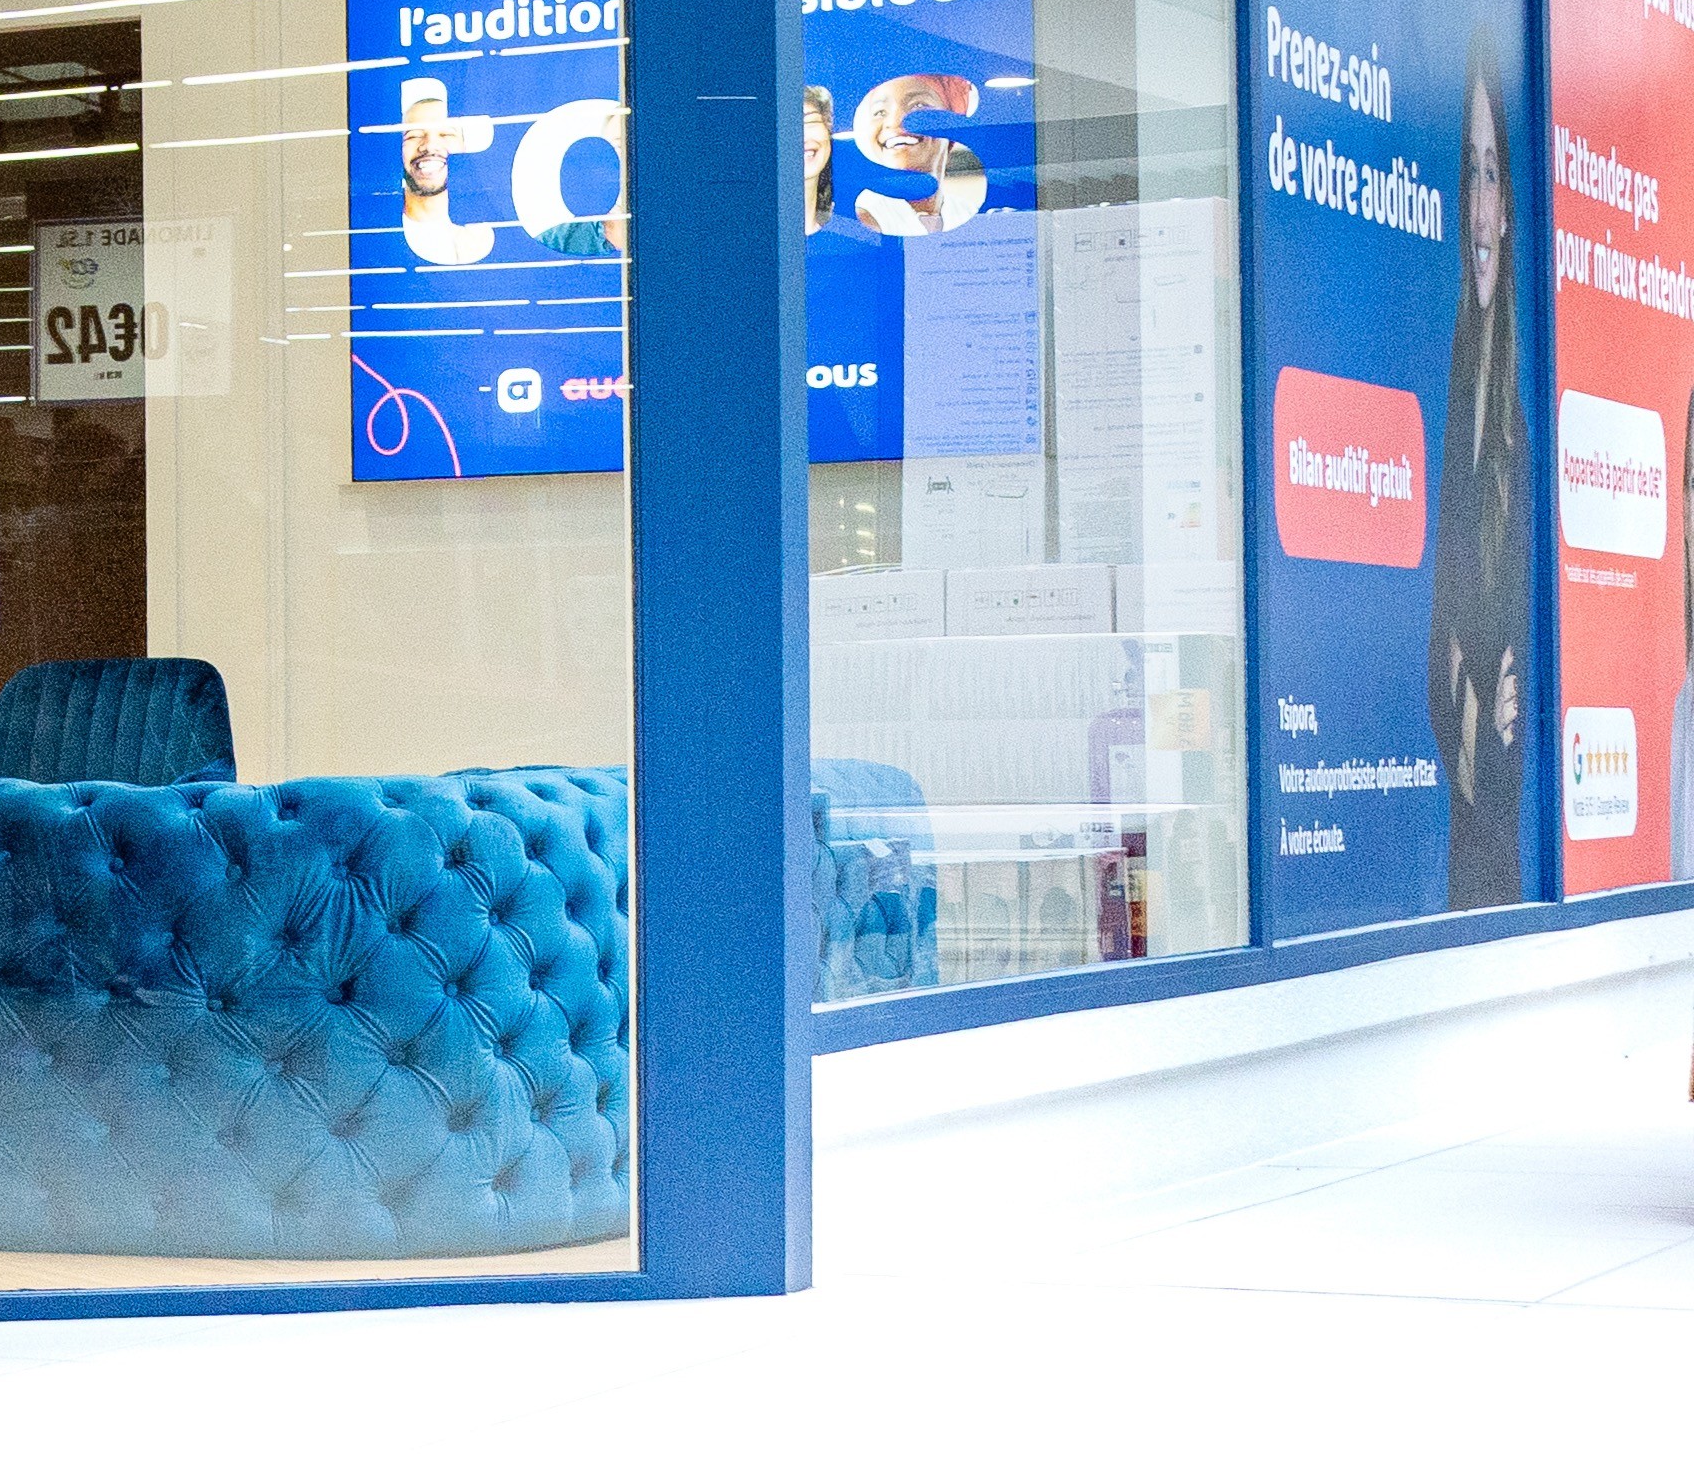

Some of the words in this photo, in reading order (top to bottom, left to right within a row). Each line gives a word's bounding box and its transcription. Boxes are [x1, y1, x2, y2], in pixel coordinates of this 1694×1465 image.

[1266, 5, 1392, 123] Prenez-soin
[1267, 114, 1297, 192] de
[1299, 140, 1357, 216] votre
[1361, 157, 1443, 242] audition
[1555, 126, 1632, 211] N'attendez
[1633, 166, 1659, 231] pas
[1556, 231, 1592, 291] pour
[1595, 234, 1637, 300] mieux
[1288, 439, 1322, 488] Bilan
[1324, 444, 1369, 496] auditif
[1369, 458, 1413, 507] gratuit
[1277, 694, 1318, 739] Tsipora,
[1278, 763, 1304, 793] Votre
[1289, 825, 1313, 856] votre
